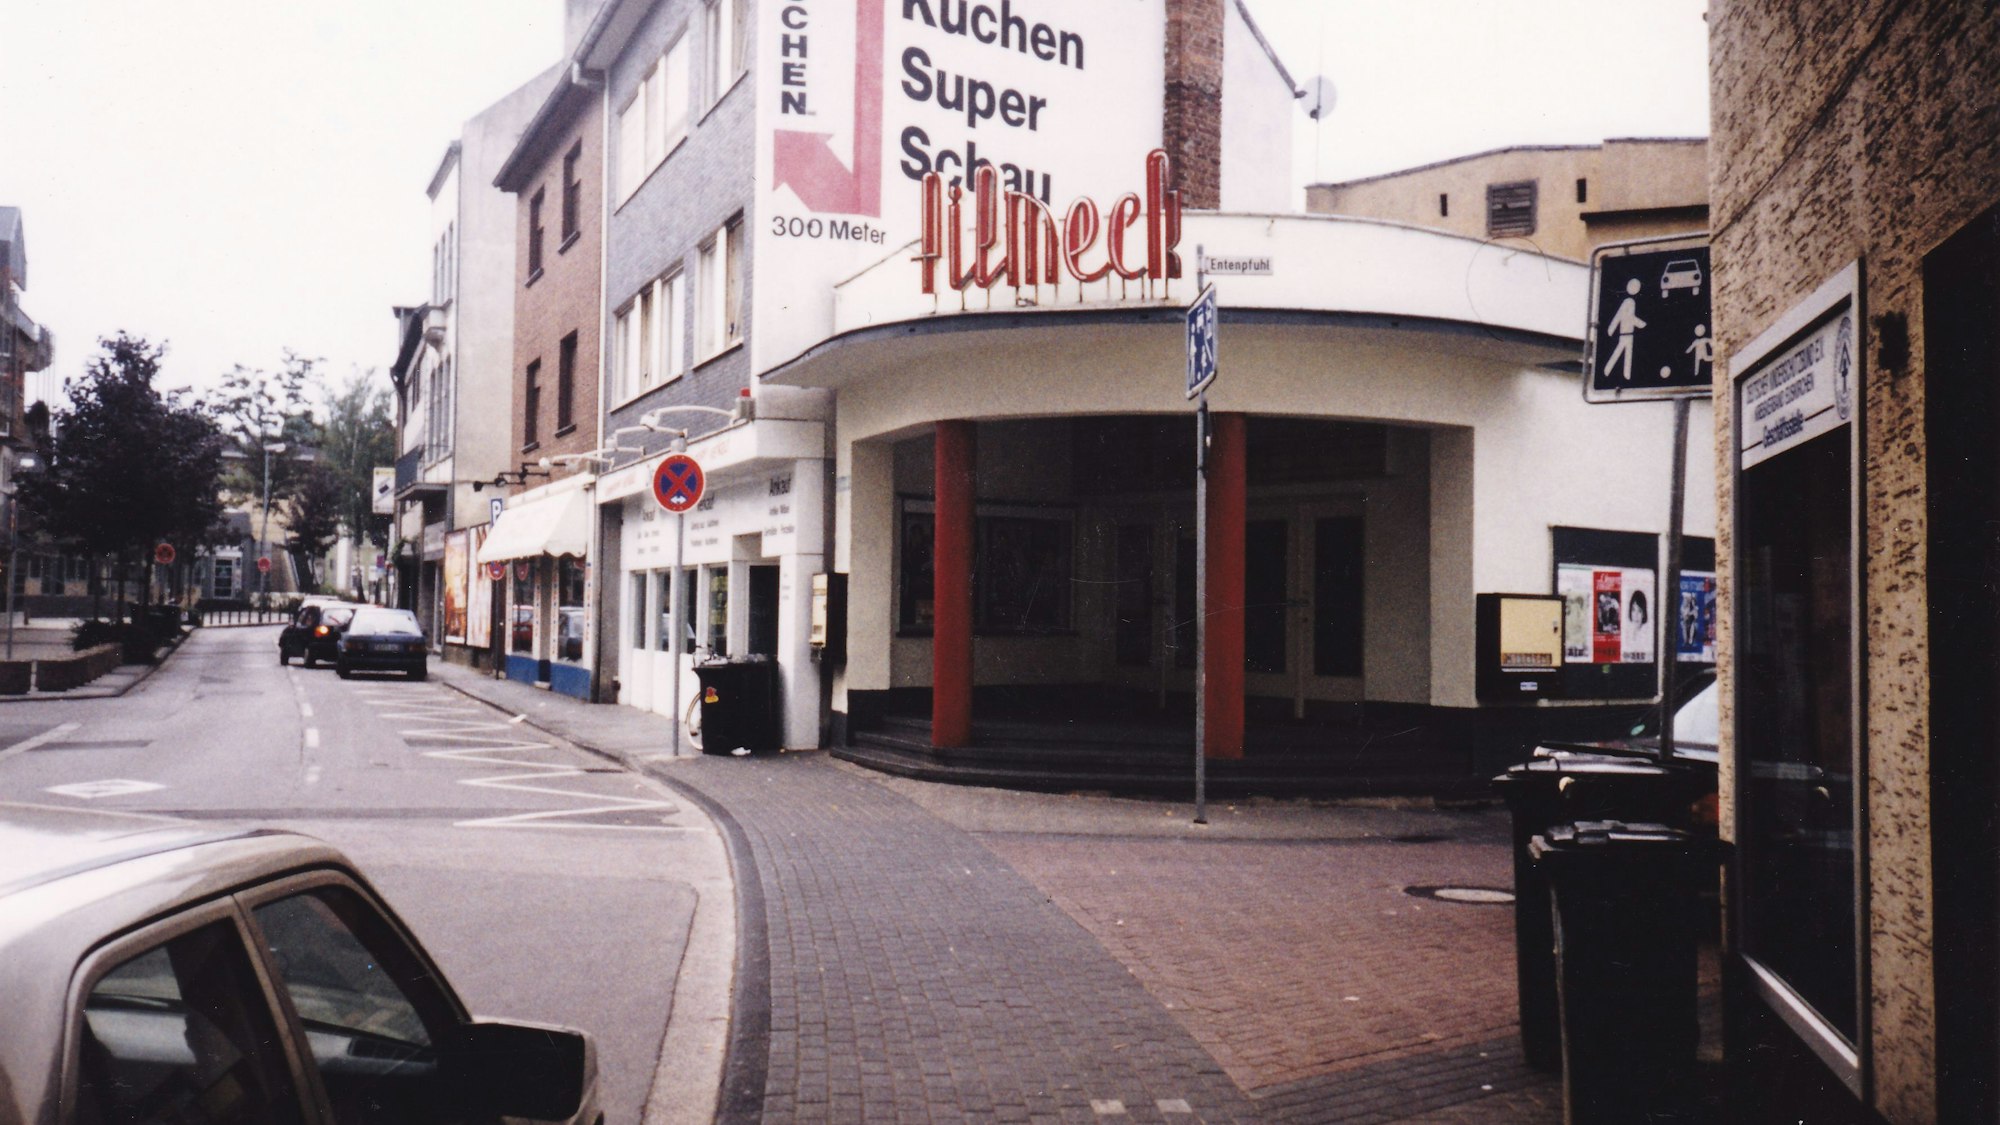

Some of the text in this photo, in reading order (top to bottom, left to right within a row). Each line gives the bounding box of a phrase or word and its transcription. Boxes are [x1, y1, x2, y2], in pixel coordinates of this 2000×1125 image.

[781, 0, 808, 115] CHEN
[901, 46, 1047, 131] Super
[772, 216, 886, 245] 300 Meter
[1210, 258, 1270, 273] Entenpfuhl
